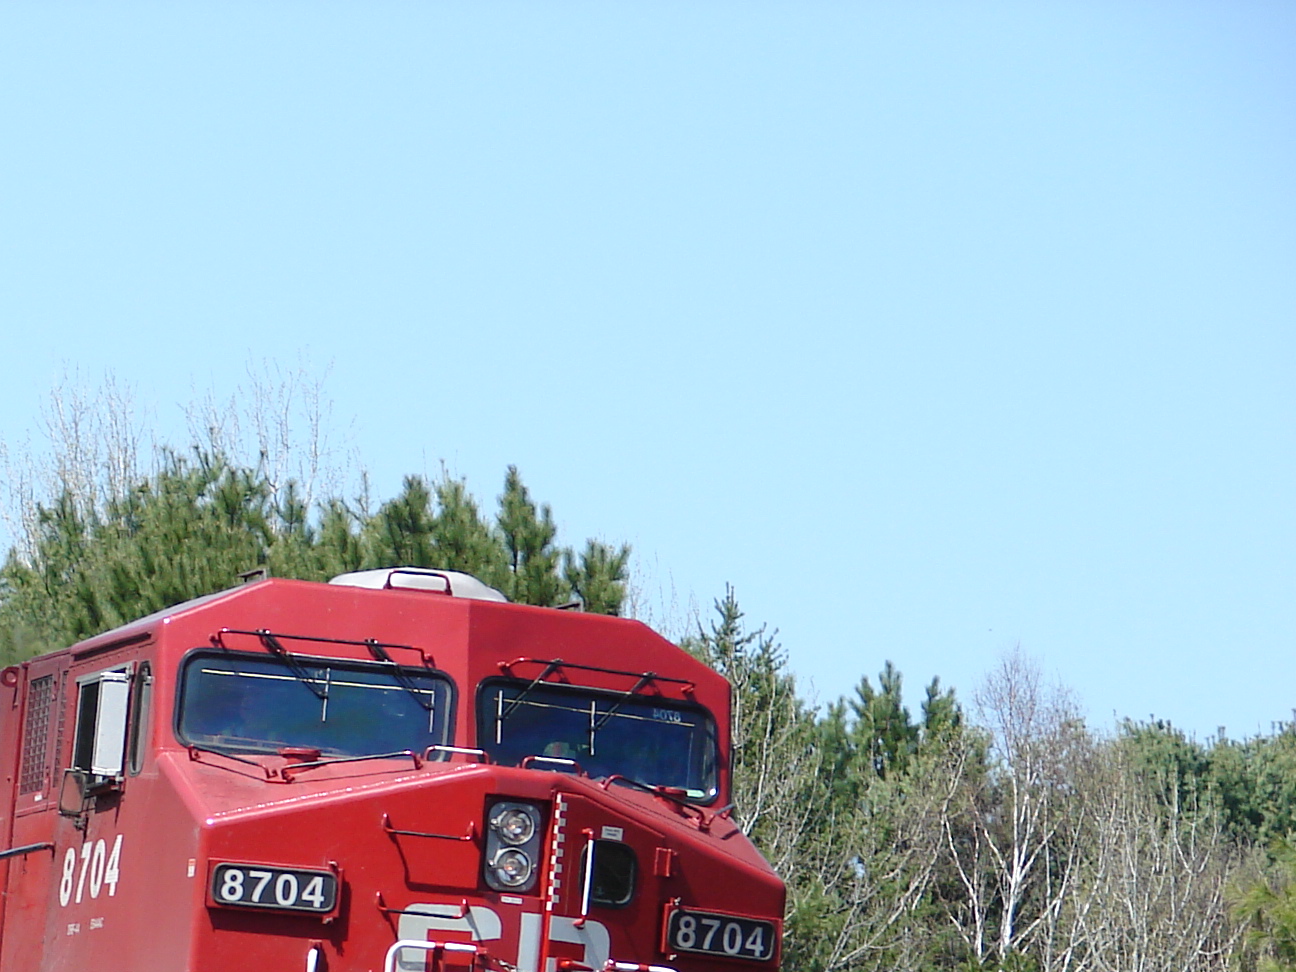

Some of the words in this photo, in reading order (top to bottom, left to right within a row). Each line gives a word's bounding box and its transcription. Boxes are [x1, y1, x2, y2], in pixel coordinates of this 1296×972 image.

[59, 834, 124, 908] 8704
[220, 868, 325, 909] 8704
[676, 914, 765, 958] 8704
